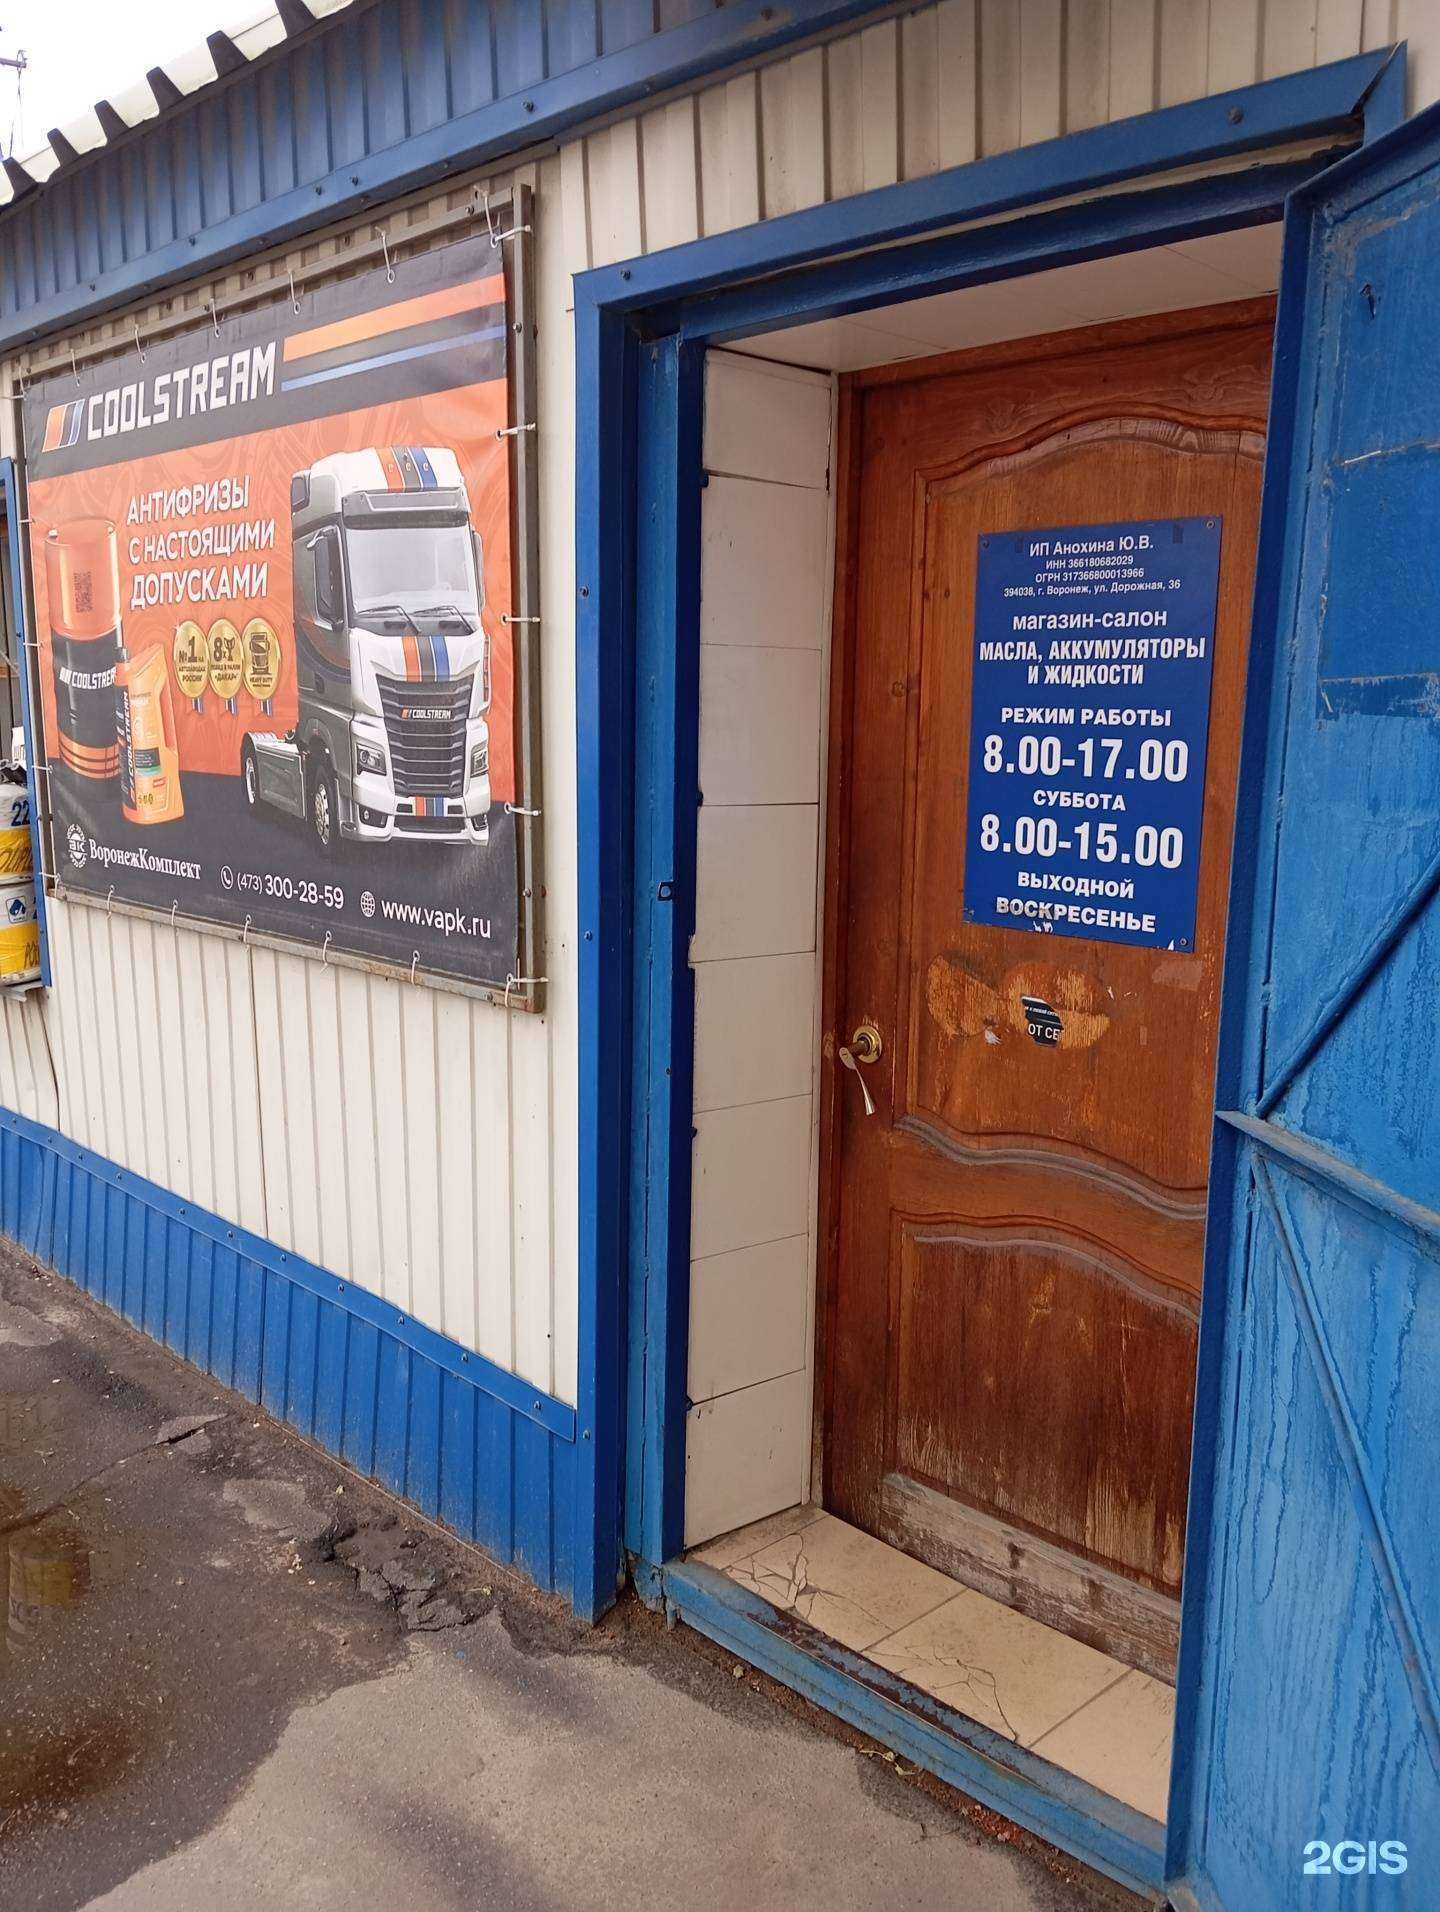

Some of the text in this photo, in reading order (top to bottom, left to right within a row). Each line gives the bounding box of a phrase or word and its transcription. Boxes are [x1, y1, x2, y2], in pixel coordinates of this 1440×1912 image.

[87, 341, 276, 441] COOLSTREAM
[126, 475, 250, 526] АНТИФРИЗЫ
[129, 519, 275, 564] С НАСТОЯЩИМИ
[1030, 535, 1154, 557] ИП Анохина Ю.В.
[1035, 568, 1145, 583] ОГРН 317366800013966
[1046, 556, 1134, 569] ИНН 366180682029
[130, 562, 269, 611] ДОПУСКАМИ
[1046, 585, 1092, 596] Воронеж,
[1093, 584, 1108, 595] ул.
[1110, 581, 1166, 593] Дорожная,
[1168, 579, 1181, 589] 36
[1012, 610, 1168, 630] магазин-салон
[979, 637, 1206, 662] МАСЛА, АККУМУЛЯТОРЫ
[1027, 664, 1144, 688] И ЖИДКОСТИ
[412, 709, 451, 719] COOLSTREAM
[1001, 707, 1171, 727] РЕЖИМ РАБОТЫ
[983, 734, 1189, 782] 8.00-17.00
[1033, 789, 1126, 811] СУББОТА
[980, 813, 1184, 869] 8.00-15.00
[89, 838, 201, 879] ВоронежКомплект
[237, 871, 344, 910] (473) 300-28-59
[1017, 871, 1135, 899] ВЫХОДНОЙ
[381, 899, 491, 938] www.vapk.ru
[996, 896, 1156, 933] ВОСКРЕСЕНЬЕ
[1028, 1023, 1043, 1037] ОТ
